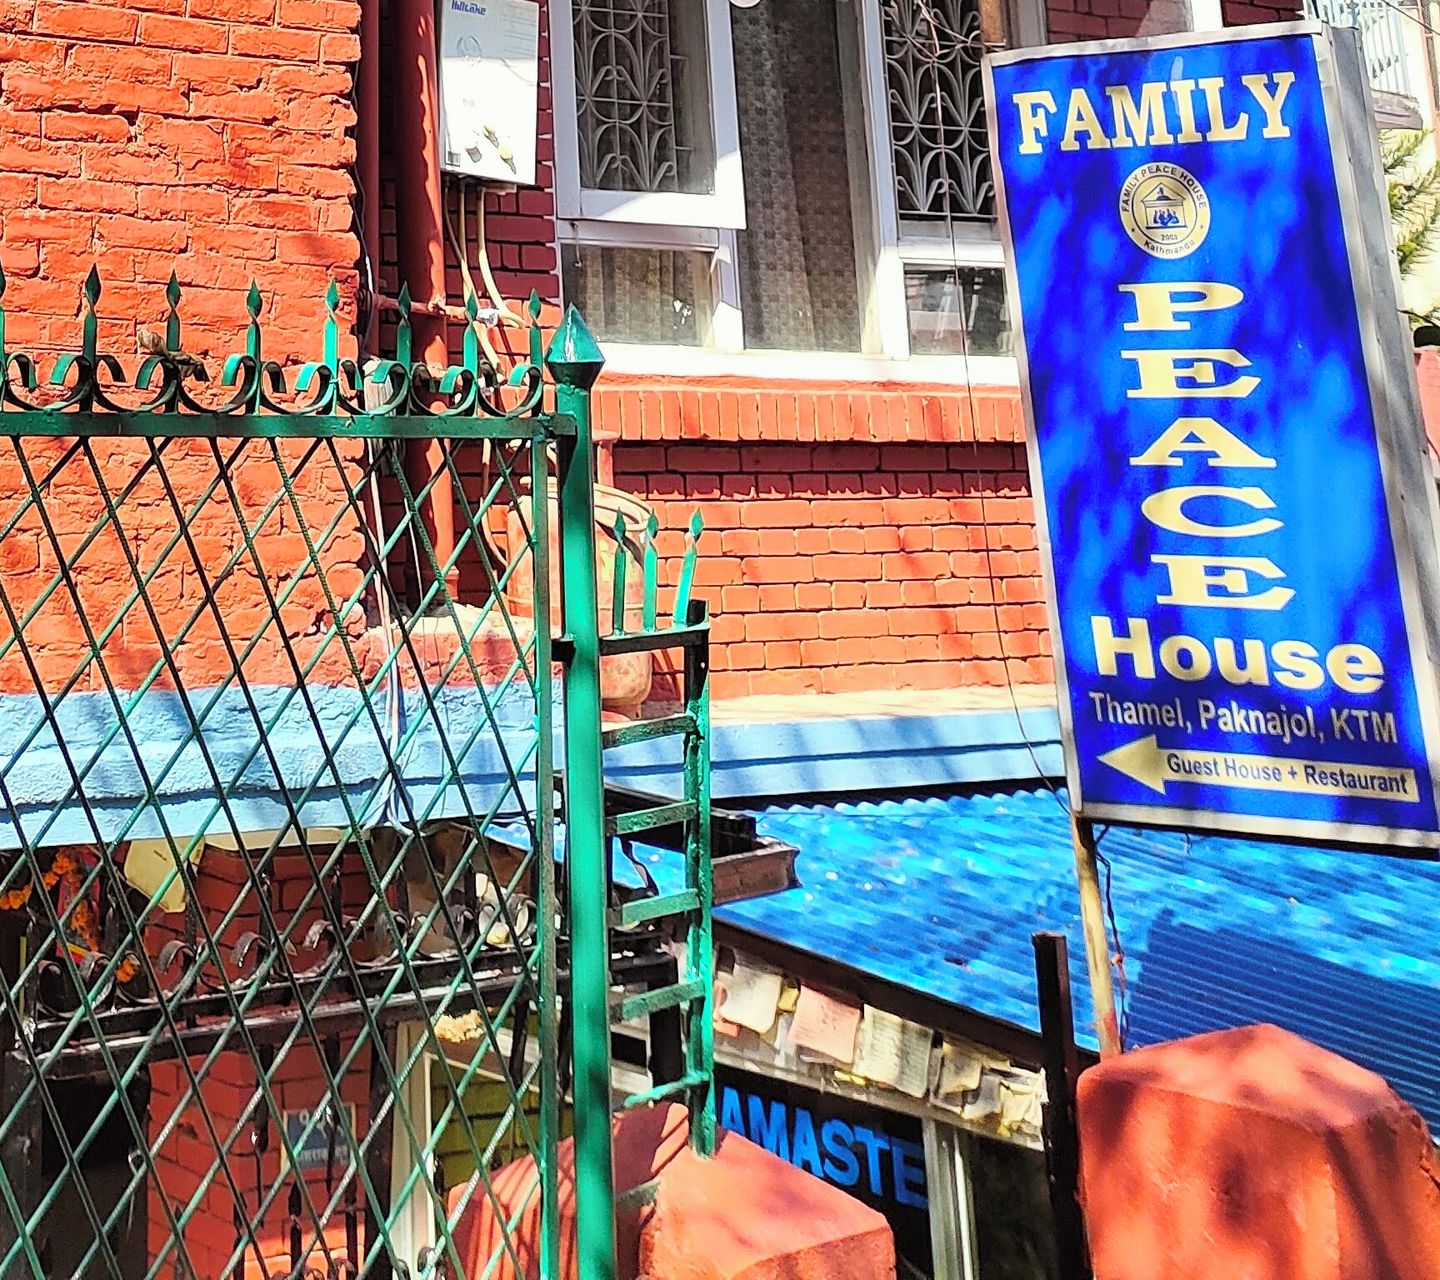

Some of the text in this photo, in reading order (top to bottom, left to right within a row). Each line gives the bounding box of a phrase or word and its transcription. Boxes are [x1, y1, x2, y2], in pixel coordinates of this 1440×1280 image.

[1013, 71, 1296, 155] FAMILY
[1121, 164, 1207, 213] FAMILY PEACE HOUSE
[1144, 239, 1195, 256] Kathmandu
[1118, 281, 1297, 611] PEACE
[1090, 615, 1385, 694] House
[1088, 690, 1399, 746] Thamel, Paknajol, KTM
[1166, 753, 1221, 778] Guest
[1224, 758, 1283, 784] House
[1305, 764, 1409, 795] Restaurant
